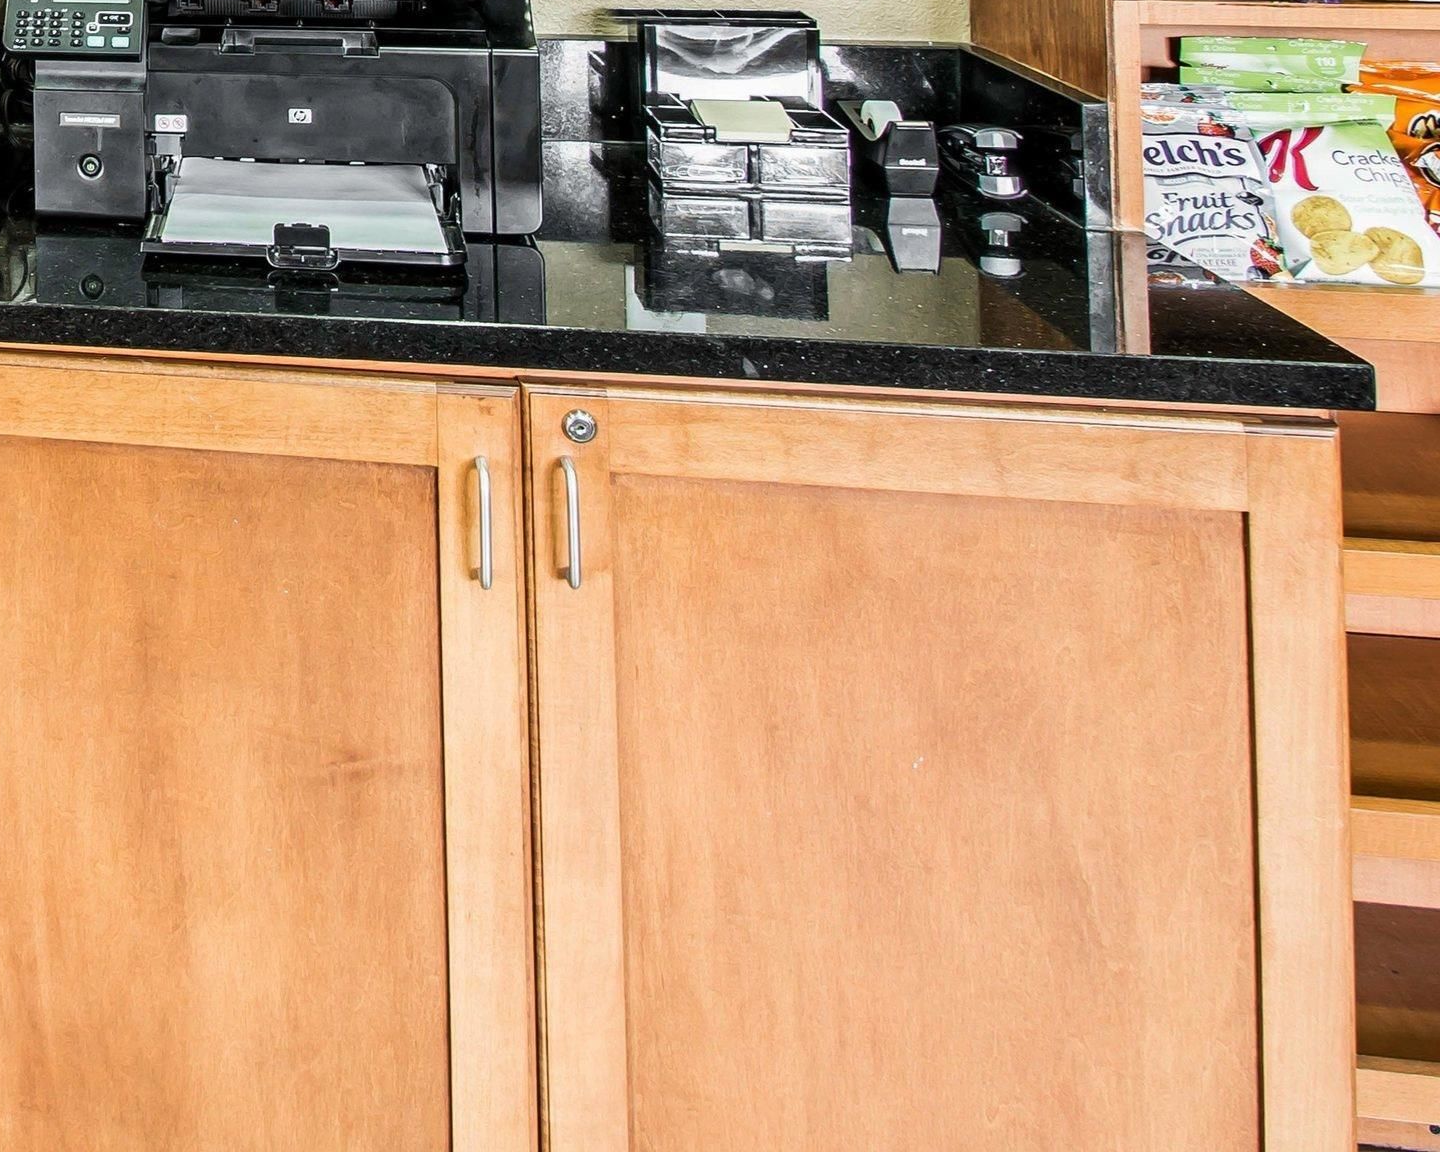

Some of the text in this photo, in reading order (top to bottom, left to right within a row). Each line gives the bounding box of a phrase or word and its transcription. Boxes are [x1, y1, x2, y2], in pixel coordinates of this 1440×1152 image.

[1143, 139, 1246, 167] elch's
[1257, 126, 1325, 192] K
[1161, 192, 1235, 212] Fruit
[1145, 209, 1256, 240] Snacks
